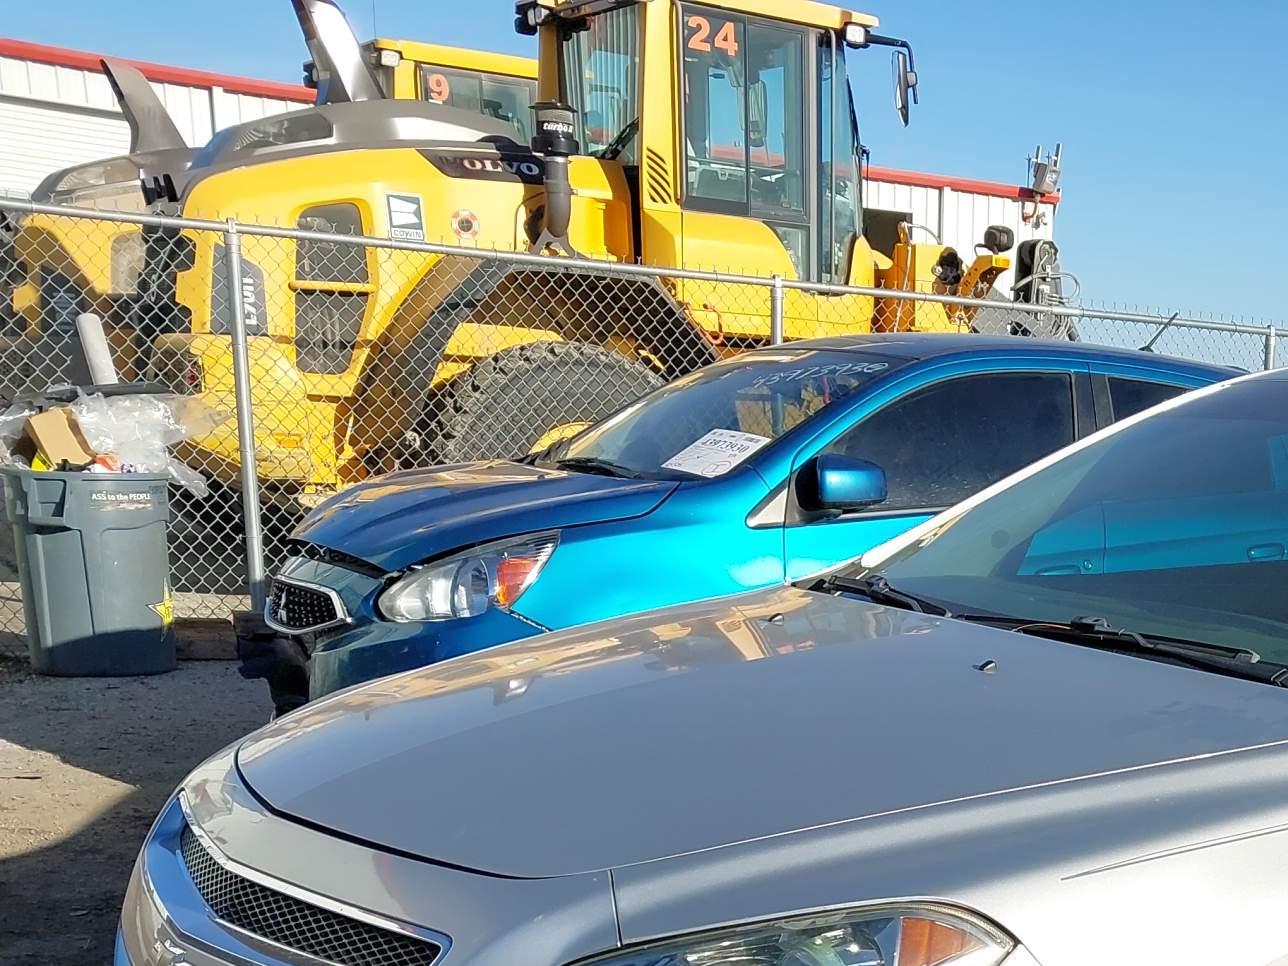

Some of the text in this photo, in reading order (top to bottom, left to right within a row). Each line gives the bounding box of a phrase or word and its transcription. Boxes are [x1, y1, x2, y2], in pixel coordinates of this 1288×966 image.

[688, 16, 738, 56] 24
[429, 74, 449, 100] 9
[543, 122, 568, 132] turbo
